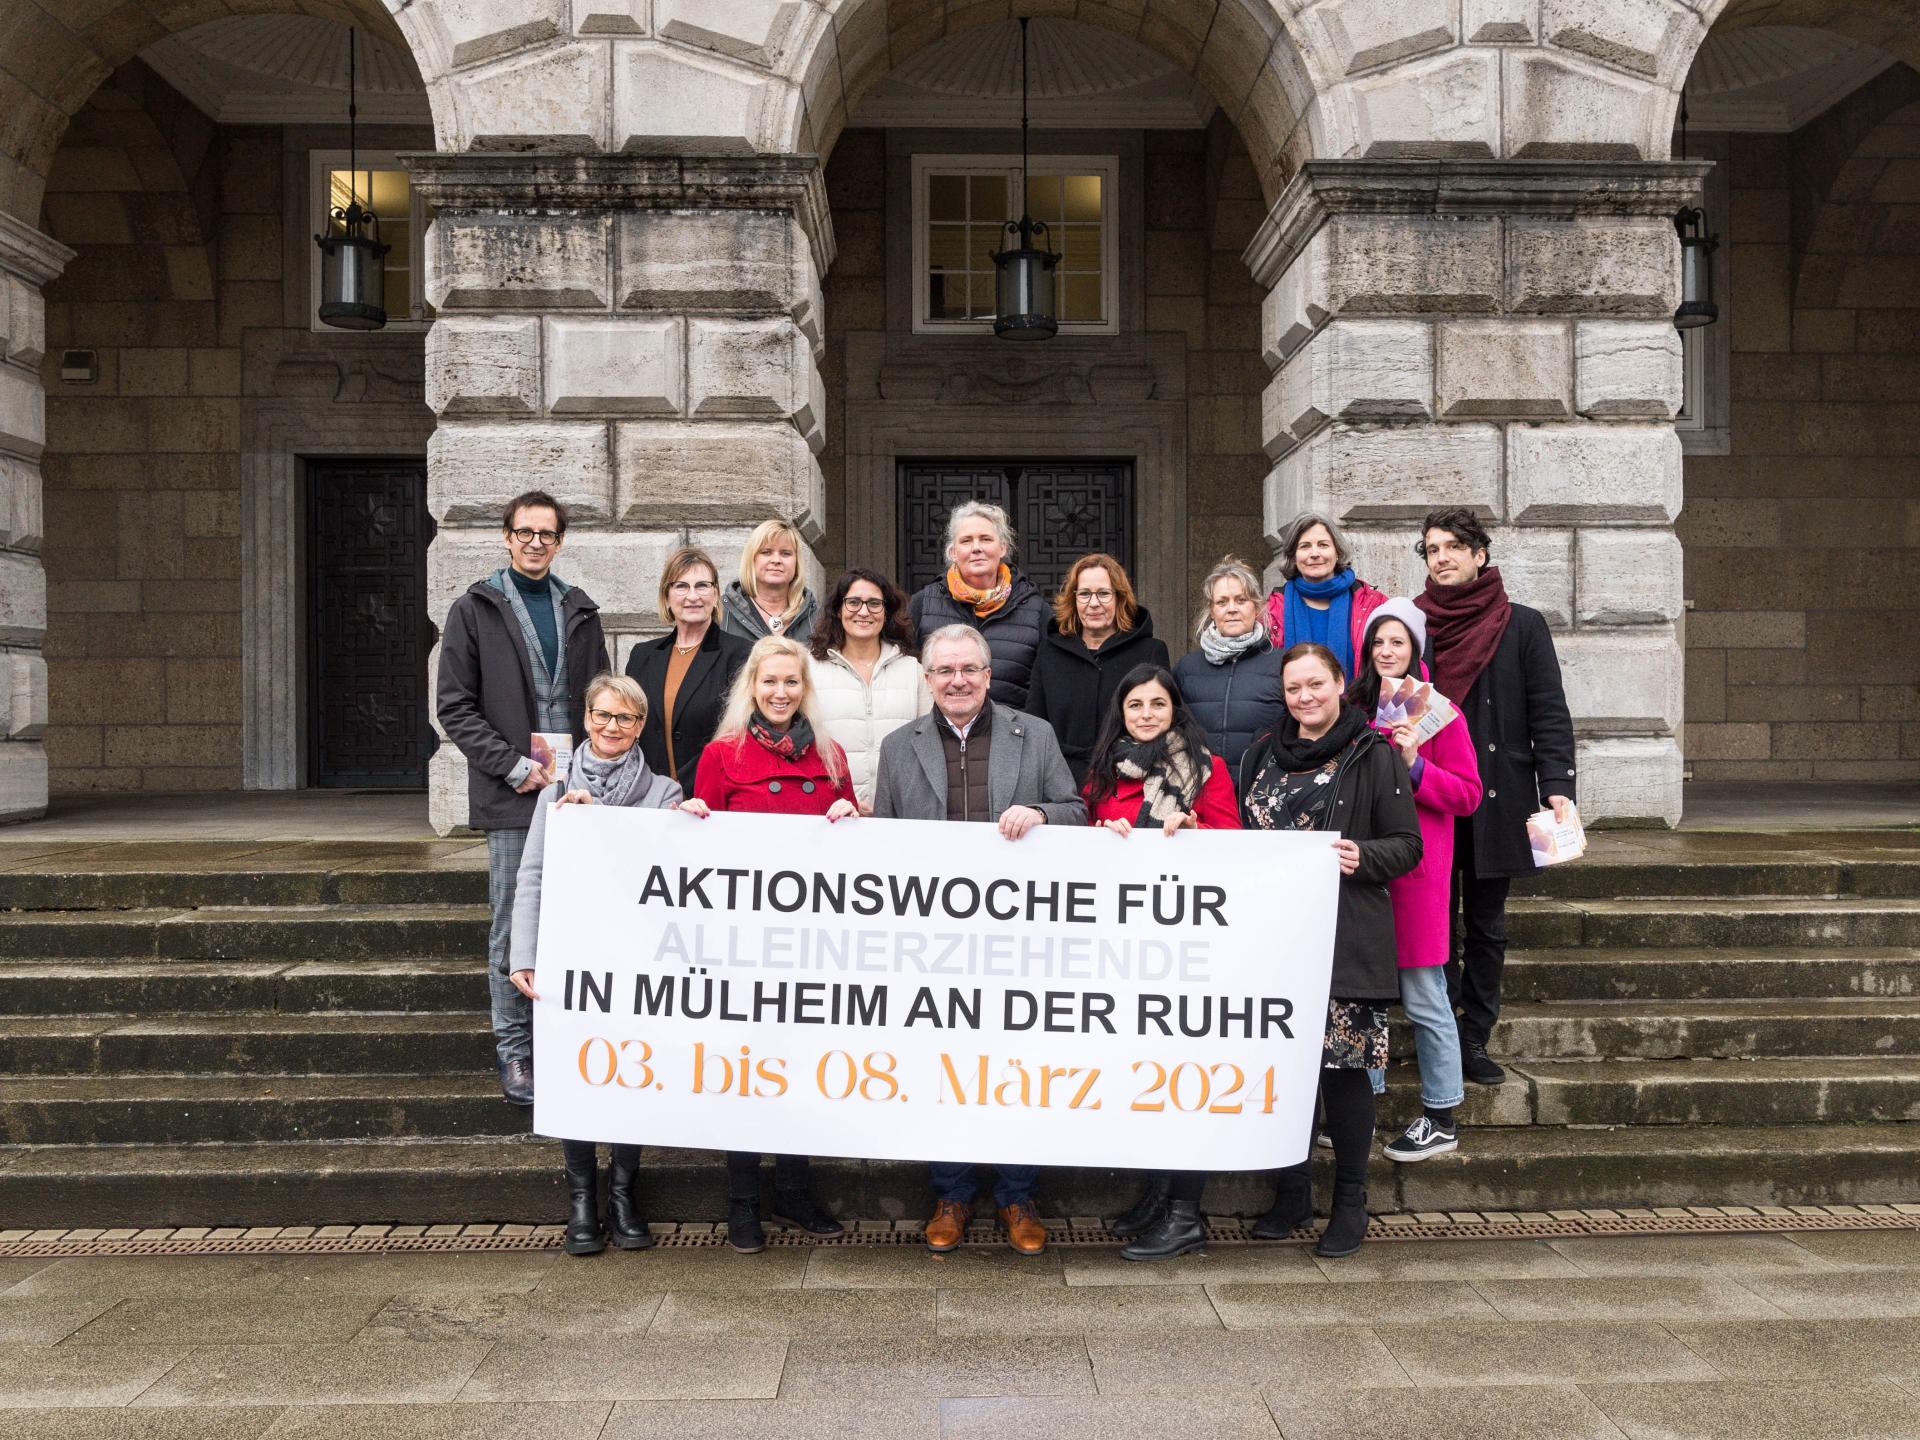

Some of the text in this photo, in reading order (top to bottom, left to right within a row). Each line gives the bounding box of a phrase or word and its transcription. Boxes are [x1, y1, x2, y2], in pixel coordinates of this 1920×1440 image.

[639, 865, 1228, 926] AKTIONSWOCHE FÜR
[654, 922, 1210, 981] ALLEINERZIEHENDE
[564, 967, 1294, 1038] IN MÜLHEIM AN DER RUHR
[578, 1038, 1277, 1114] 03. bis 08. März 2024
